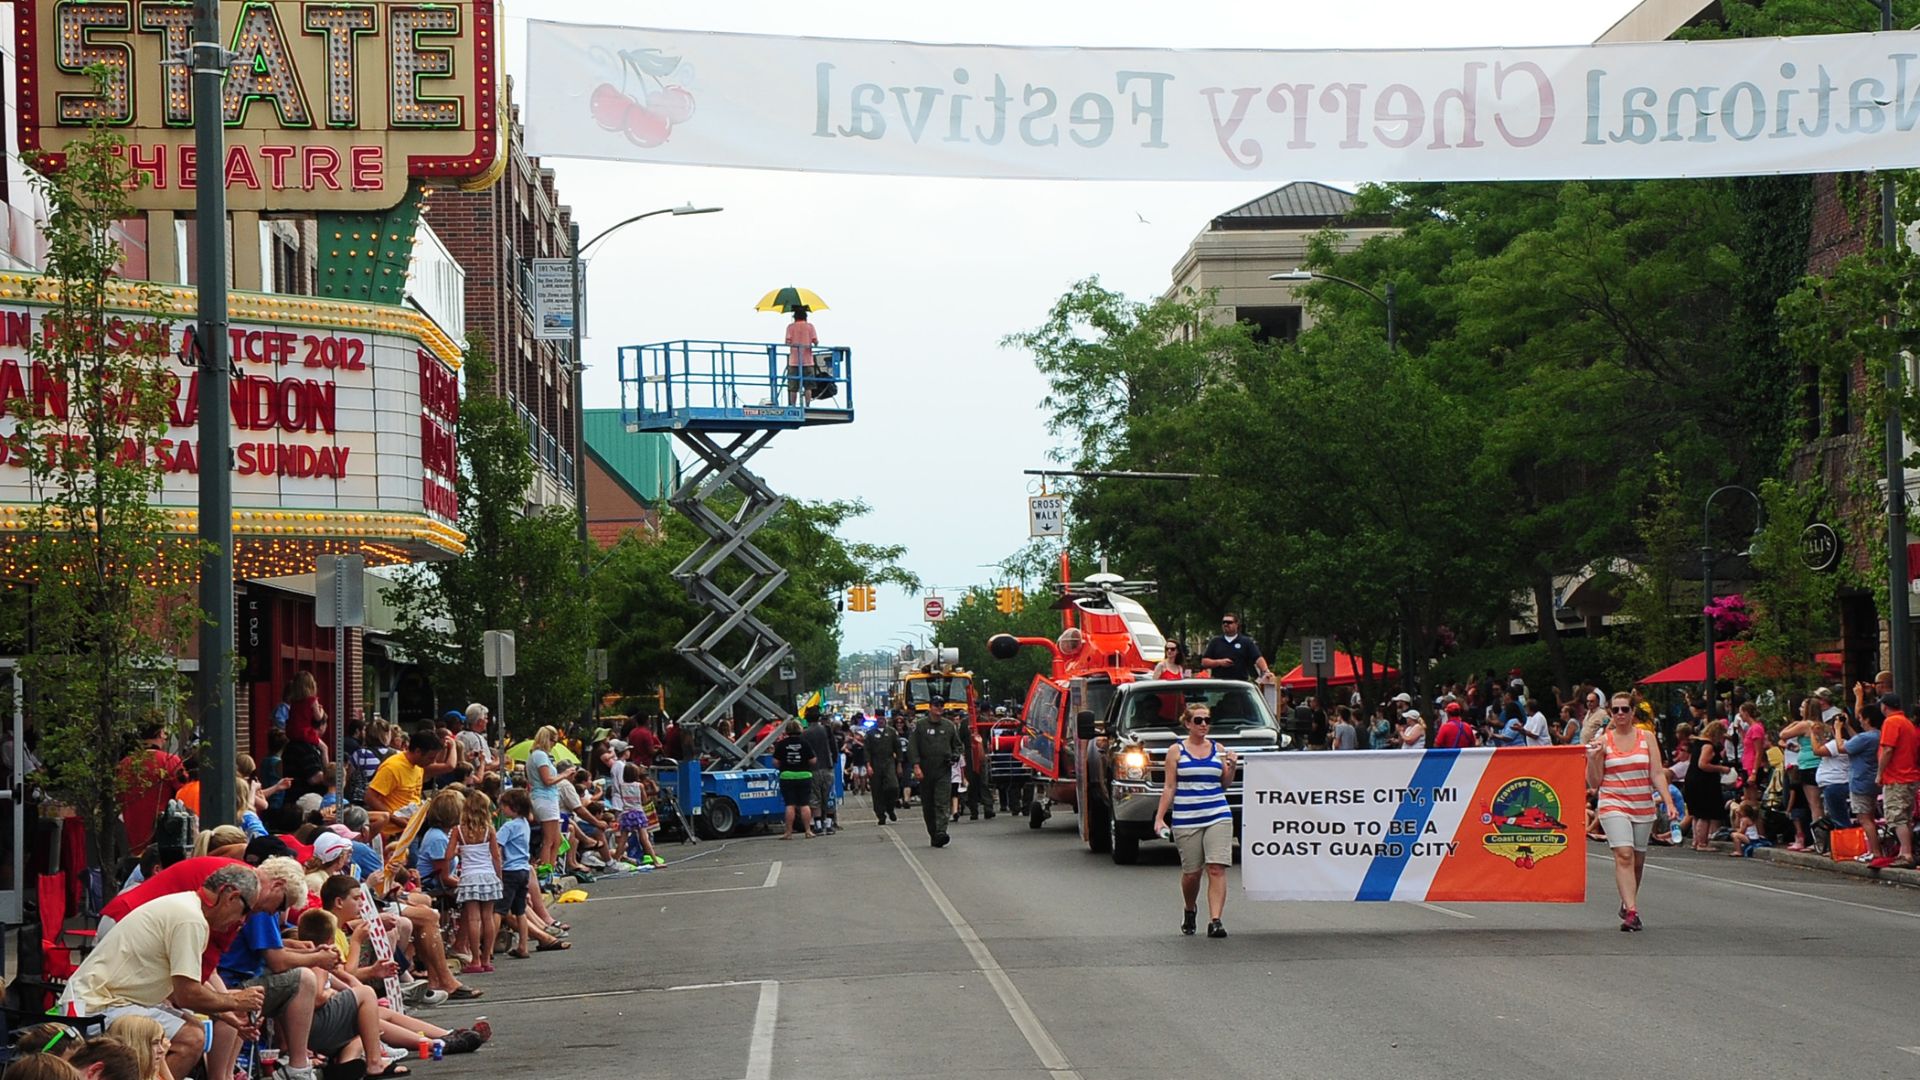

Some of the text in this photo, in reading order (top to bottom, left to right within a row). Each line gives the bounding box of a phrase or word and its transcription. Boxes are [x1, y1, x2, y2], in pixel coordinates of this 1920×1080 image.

[55, 0, 465, 128] STATE
[43, 312, 171, 357] PSON
[229, 329, 298, 366] TCFF
[304, 335, 366, 371] 2012
[237, 442, 351, 480] SUNDAY
[1031, 499, 1060, 510] CROSS
[1035, 510, 1058, 521] WALK
[1802, 534, 1832, 554] ALI'S
[1255, 788, 1457, 806] TRAVERSE CITY, MI
[1496, 780, 1528, 803] Traverse
[1544, 791, 1556, 803] MI
[1273, 820, 1438, 835] PROUD TO BE A
[1491, 834, 1559, 844] Coast Guard City
[1251, 842, 1459, 857] COAST GUARD CITY
